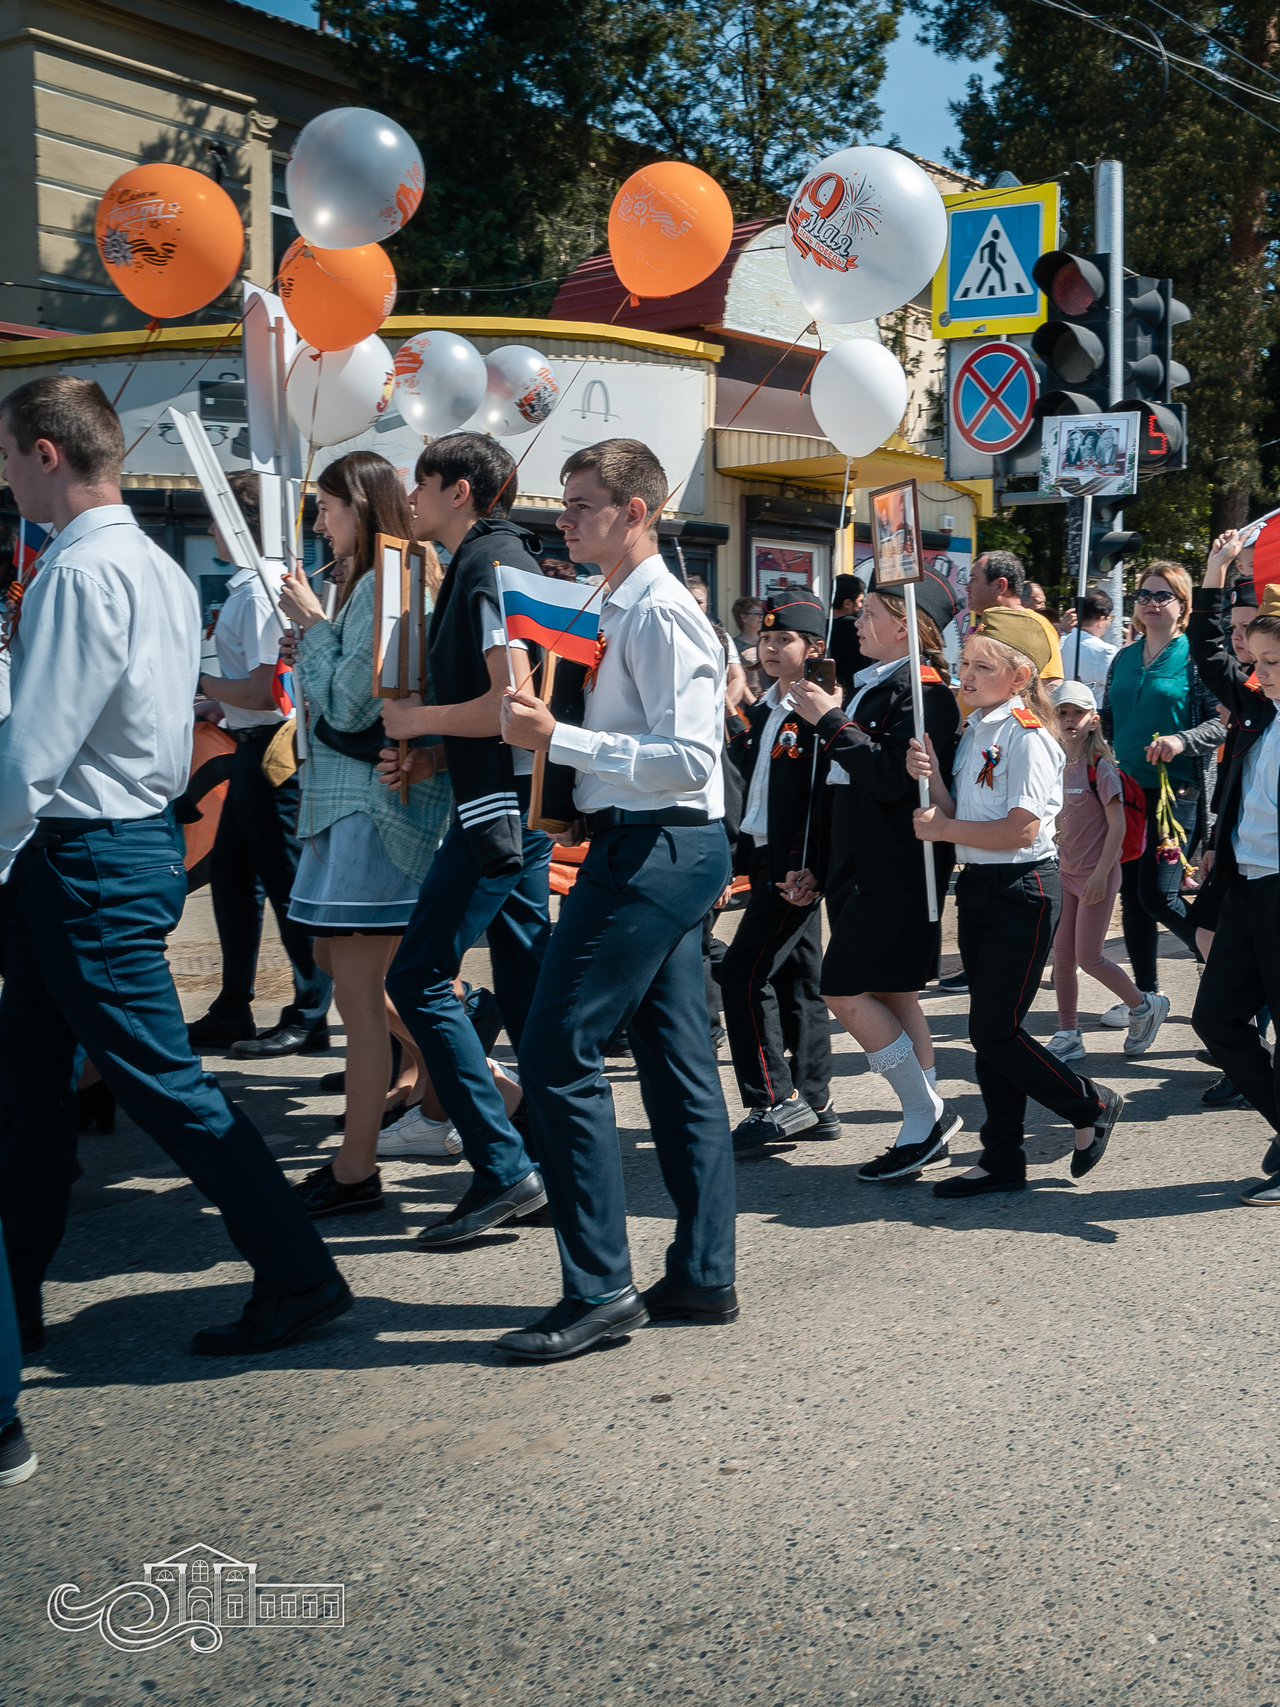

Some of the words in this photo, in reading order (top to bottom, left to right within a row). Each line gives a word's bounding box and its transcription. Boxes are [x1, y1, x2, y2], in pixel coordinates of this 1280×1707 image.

[808, 172, 847, 223] 9
[798, 228, 813, 245] ДЕНЬ
[814, 241, 845, 266] ПОБЕДЫ
